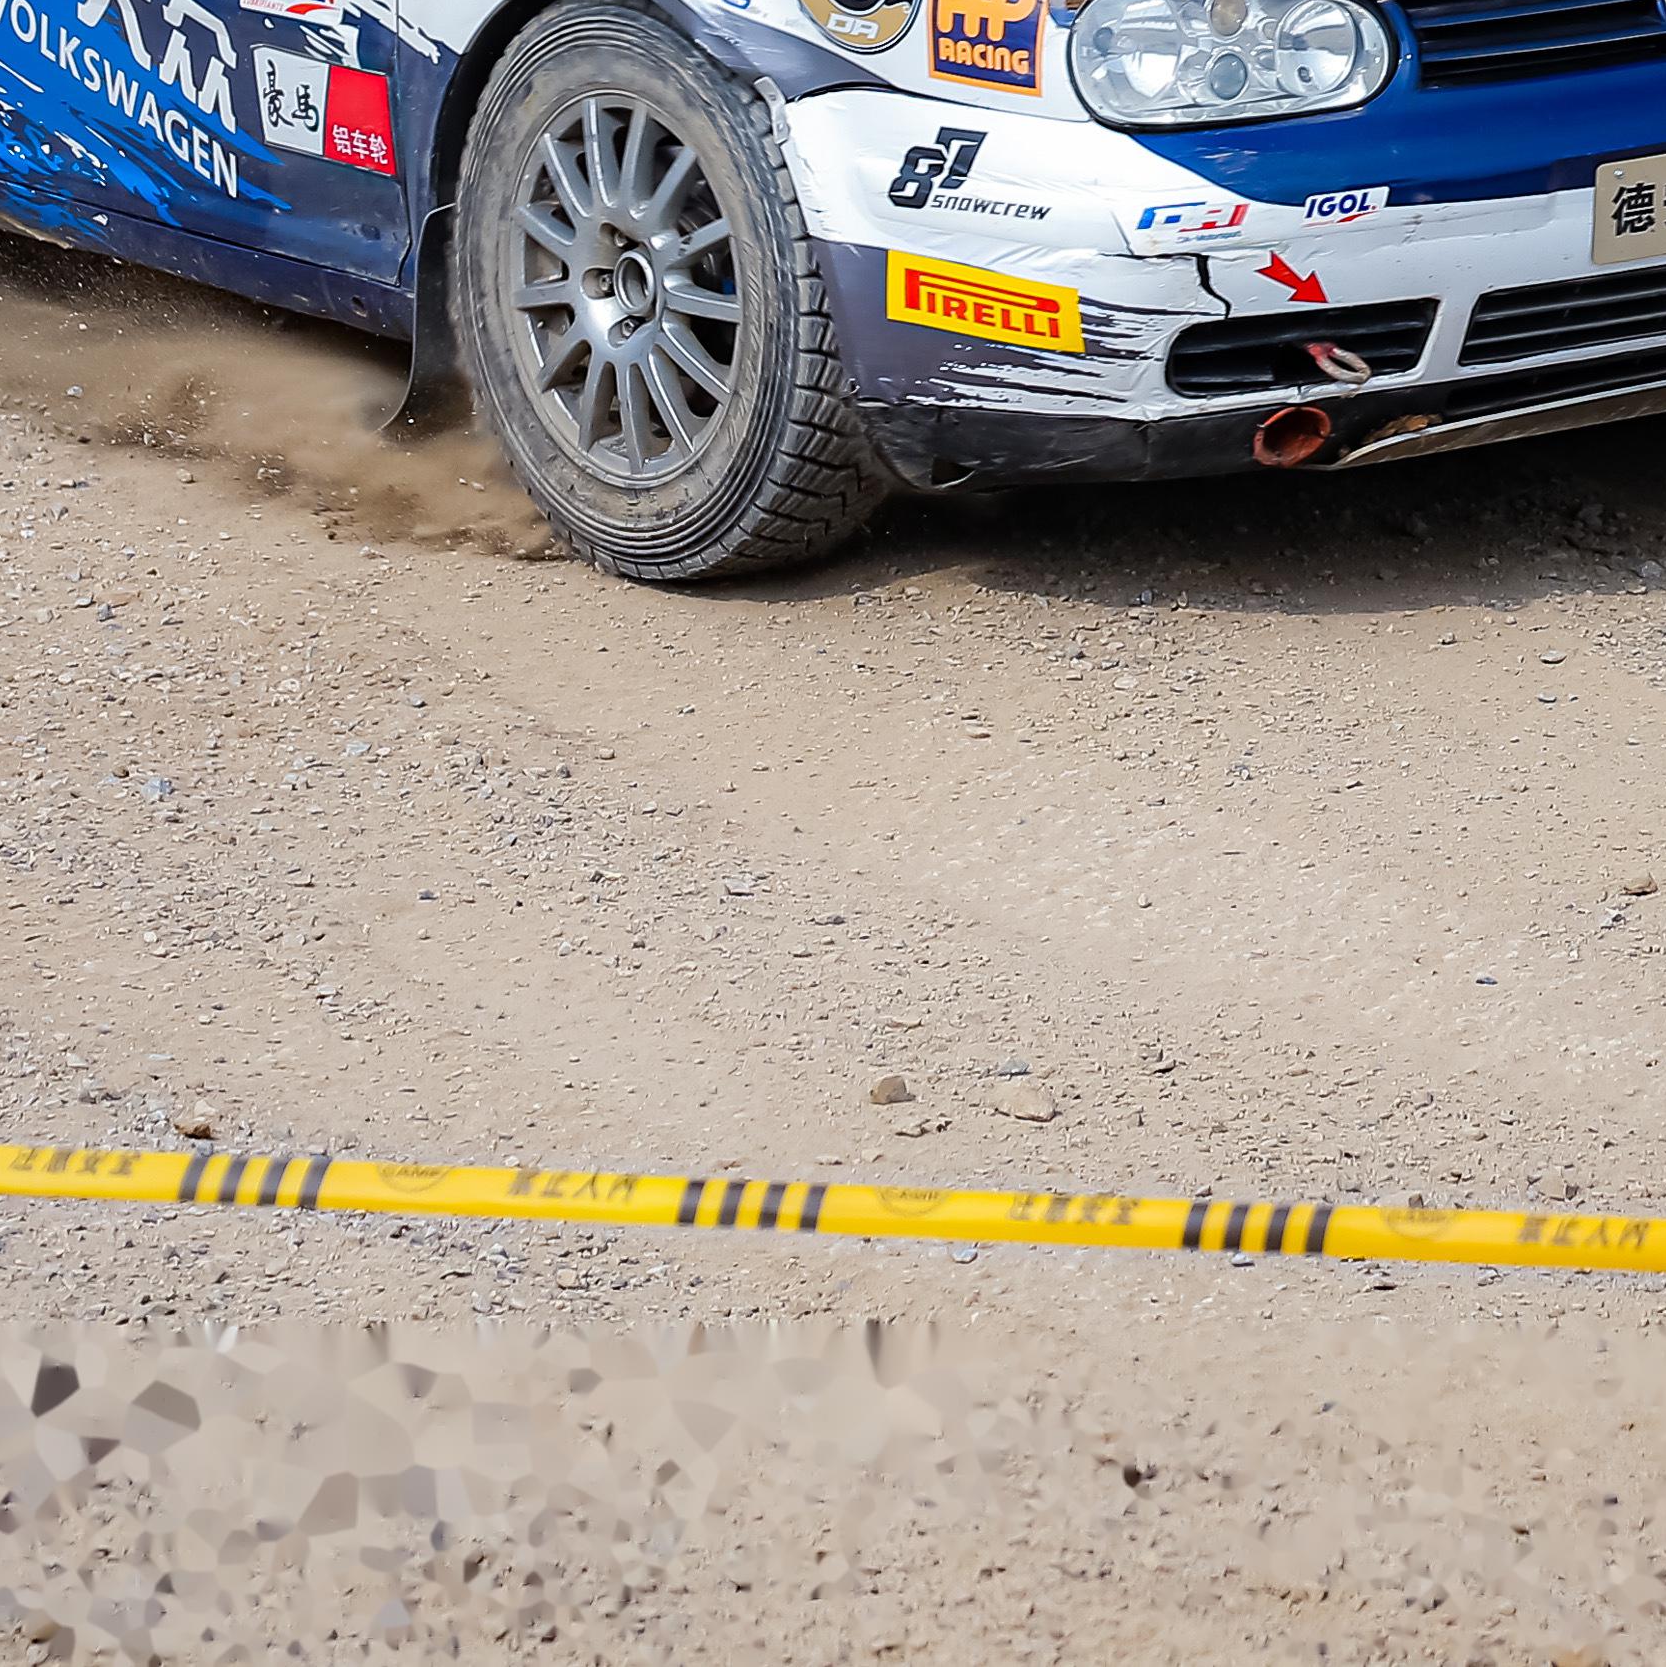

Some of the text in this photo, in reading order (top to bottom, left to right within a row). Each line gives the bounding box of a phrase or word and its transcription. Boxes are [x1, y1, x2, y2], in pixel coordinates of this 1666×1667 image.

[827, 12, 880, 40] DA
[938, 38, 1031, 77] RACING
[904, 268, 1060, 339] PIRELLI
